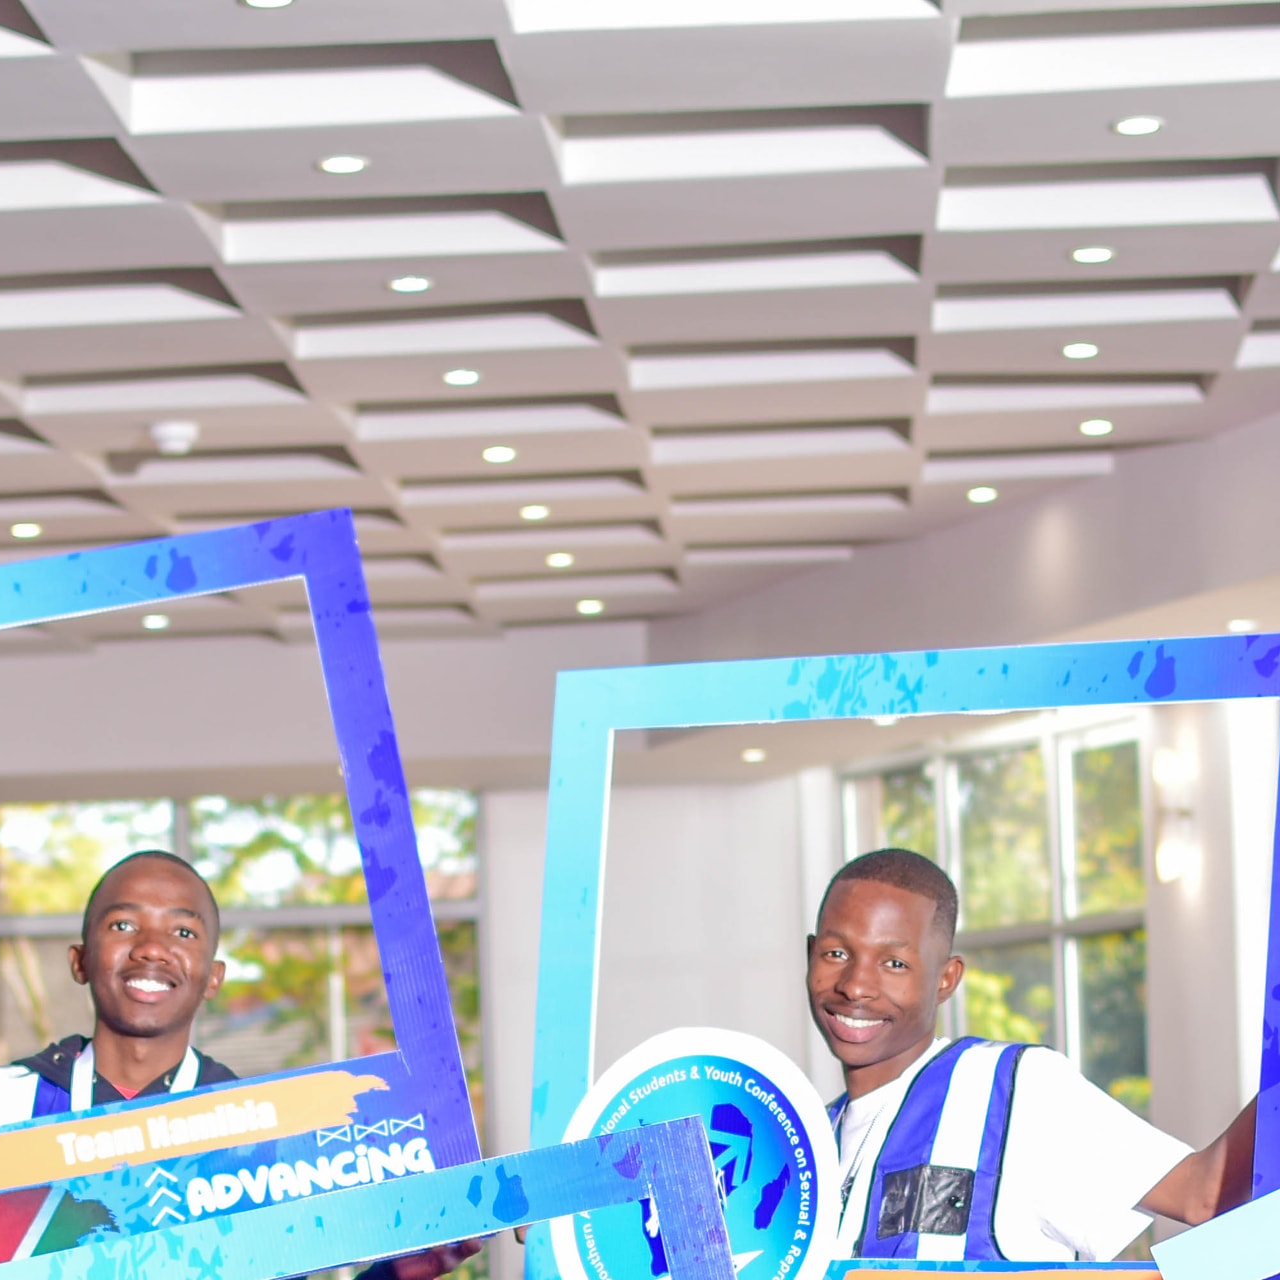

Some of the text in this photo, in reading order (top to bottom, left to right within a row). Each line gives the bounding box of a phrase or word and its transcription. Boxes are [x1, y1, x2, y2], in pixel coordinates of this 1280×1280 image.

[629, 1069, 686, 1105] Students
[690, 1066, 700, 1079] &
[704, 1066, 742, 1087] Youth
[598, 1098, 631, 1134] ional
[743, 1078, 800, 1149] Conference
[57, 1100, 277, 1164] Team Namibia
[795, 1148, 807, 1169] on
[799, 1170, 811, 1228] Sexual
[798, 1229, 807, 1241] &
